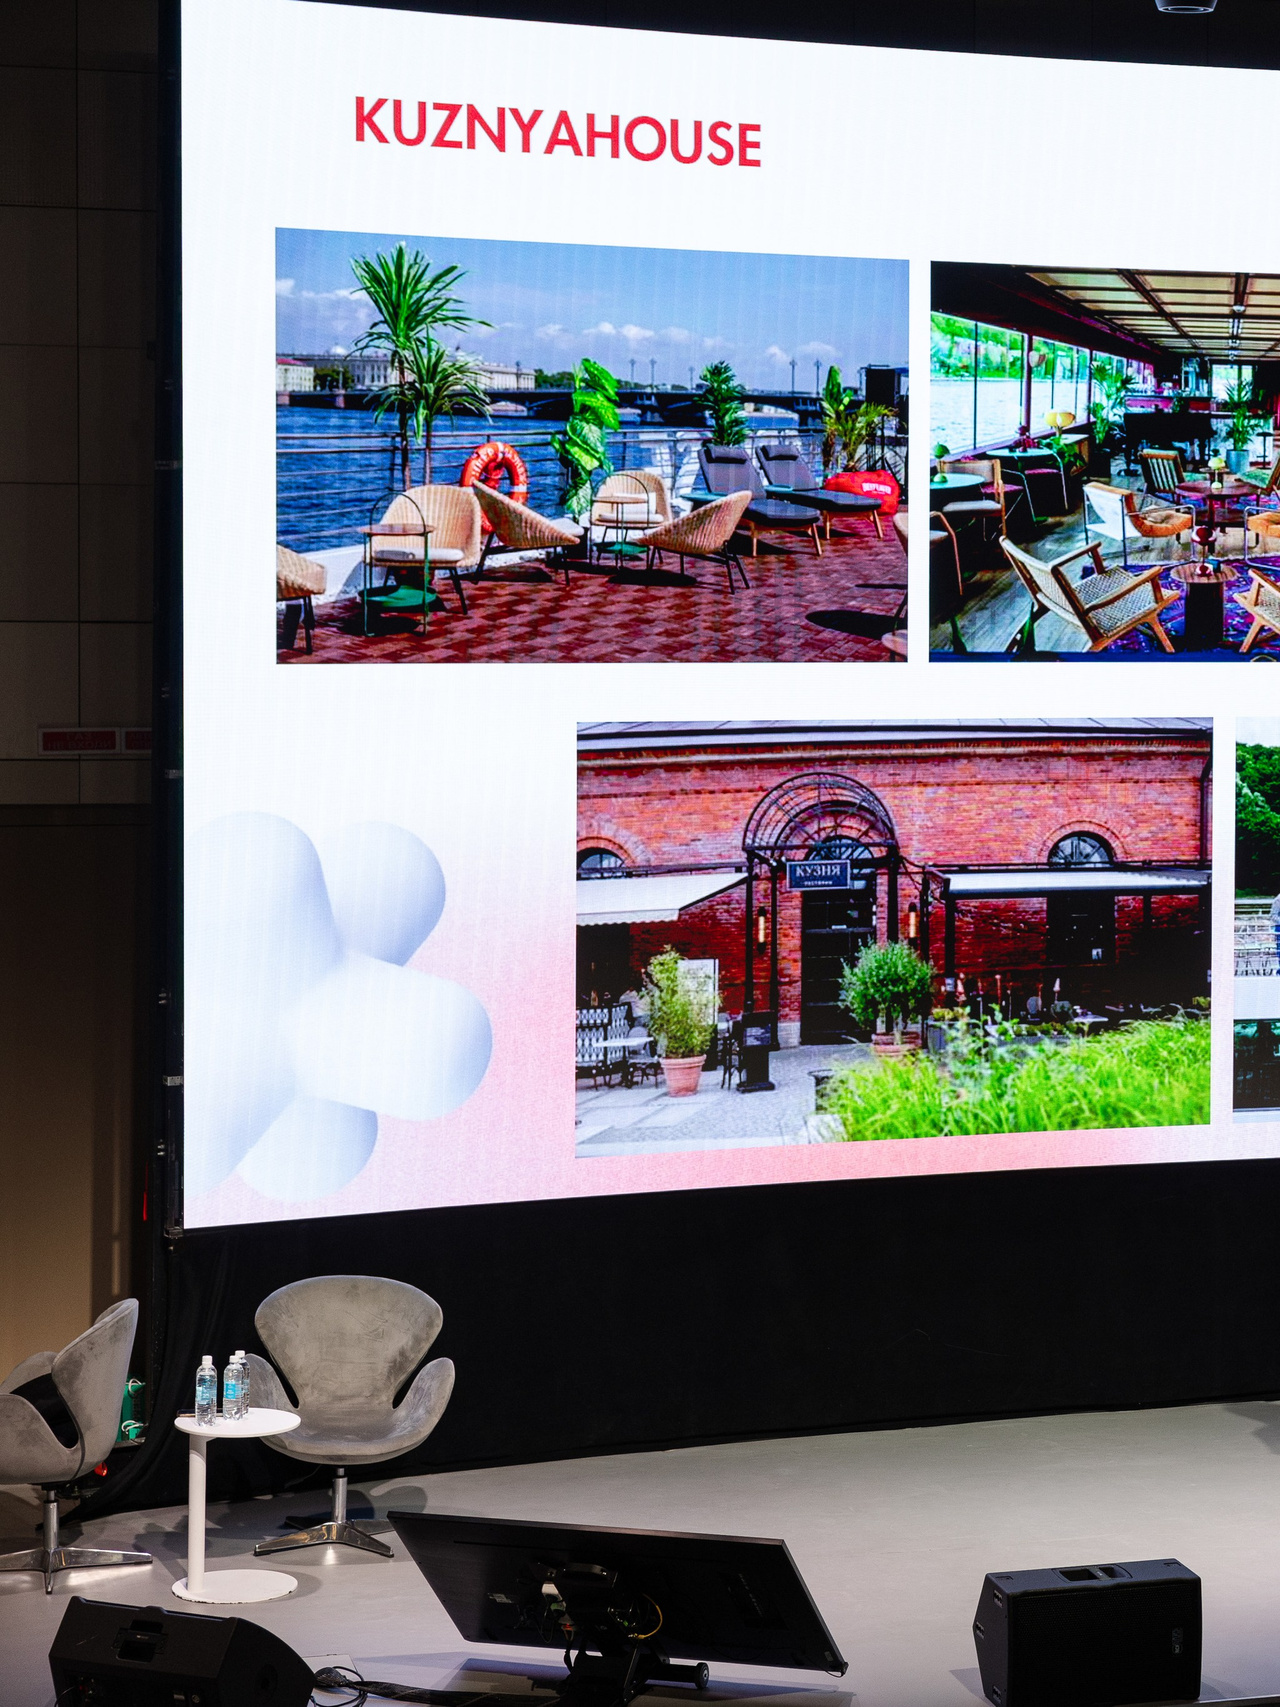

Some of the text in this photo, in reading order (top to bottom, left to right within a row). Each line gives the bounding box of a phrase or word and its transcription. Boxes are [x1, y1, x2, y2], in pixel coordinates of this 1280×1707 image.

[355, 96, 761, 167] KUZNYAHOUSE
[66, 732, 92, 741] ГАЗ
[47, 741, 65, 750] НЕ
[795, 864, 841, 877] КУЗНЯ
